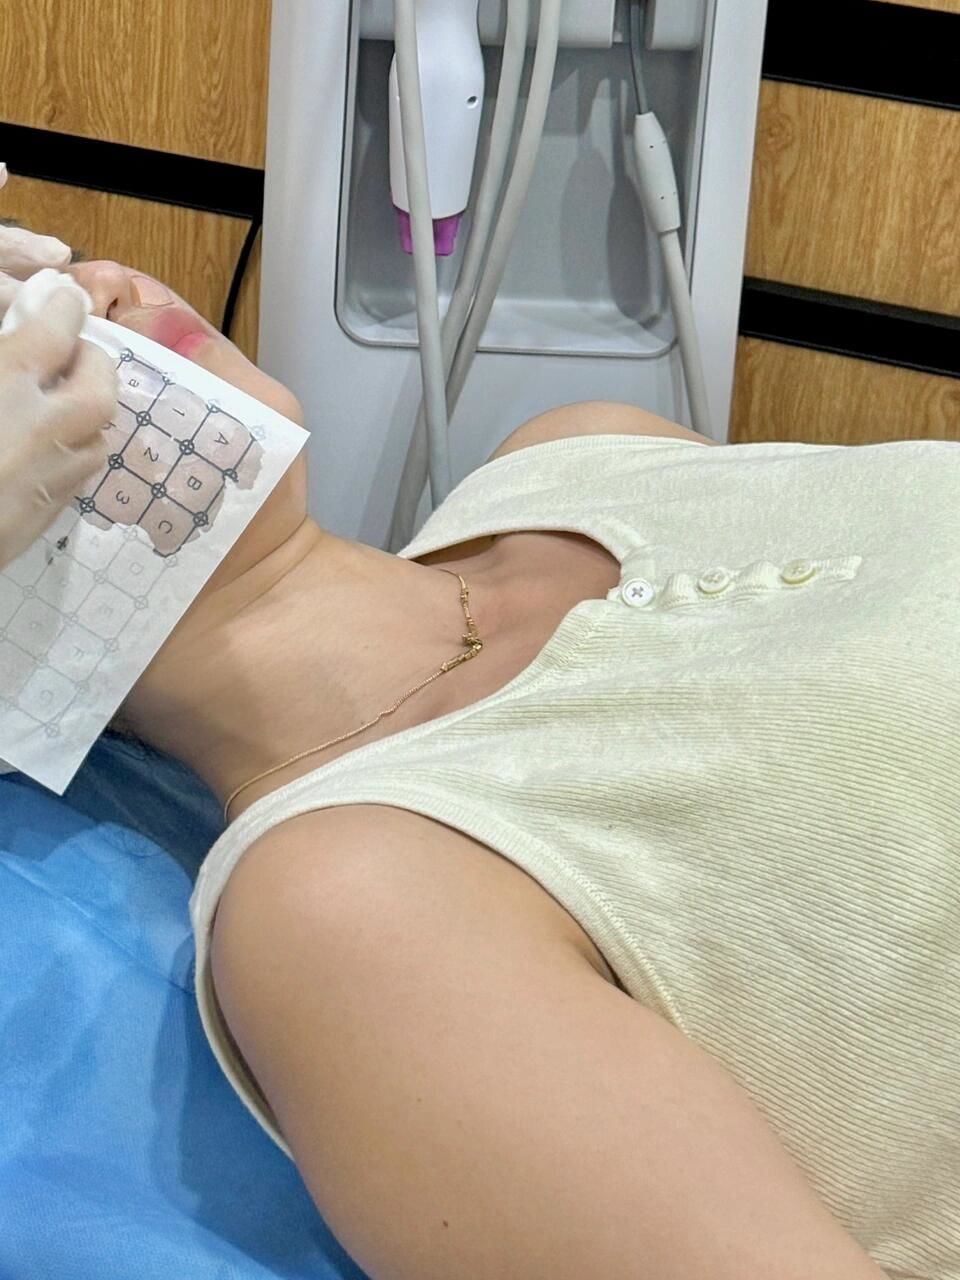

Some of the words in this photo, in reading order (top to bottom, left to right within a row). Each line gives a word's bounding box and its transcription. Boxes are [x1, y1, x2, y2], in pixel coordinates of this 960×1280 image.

[128, 378, 140, 389] a
[172, 407, 185, 417] 1
[214, 432, 230, 446] A
[144, 447, 159, 462] 2
[187, 475, 202, 491] B
[115, 490, 130, 505] 3
[158, 521, 173, 534] C
